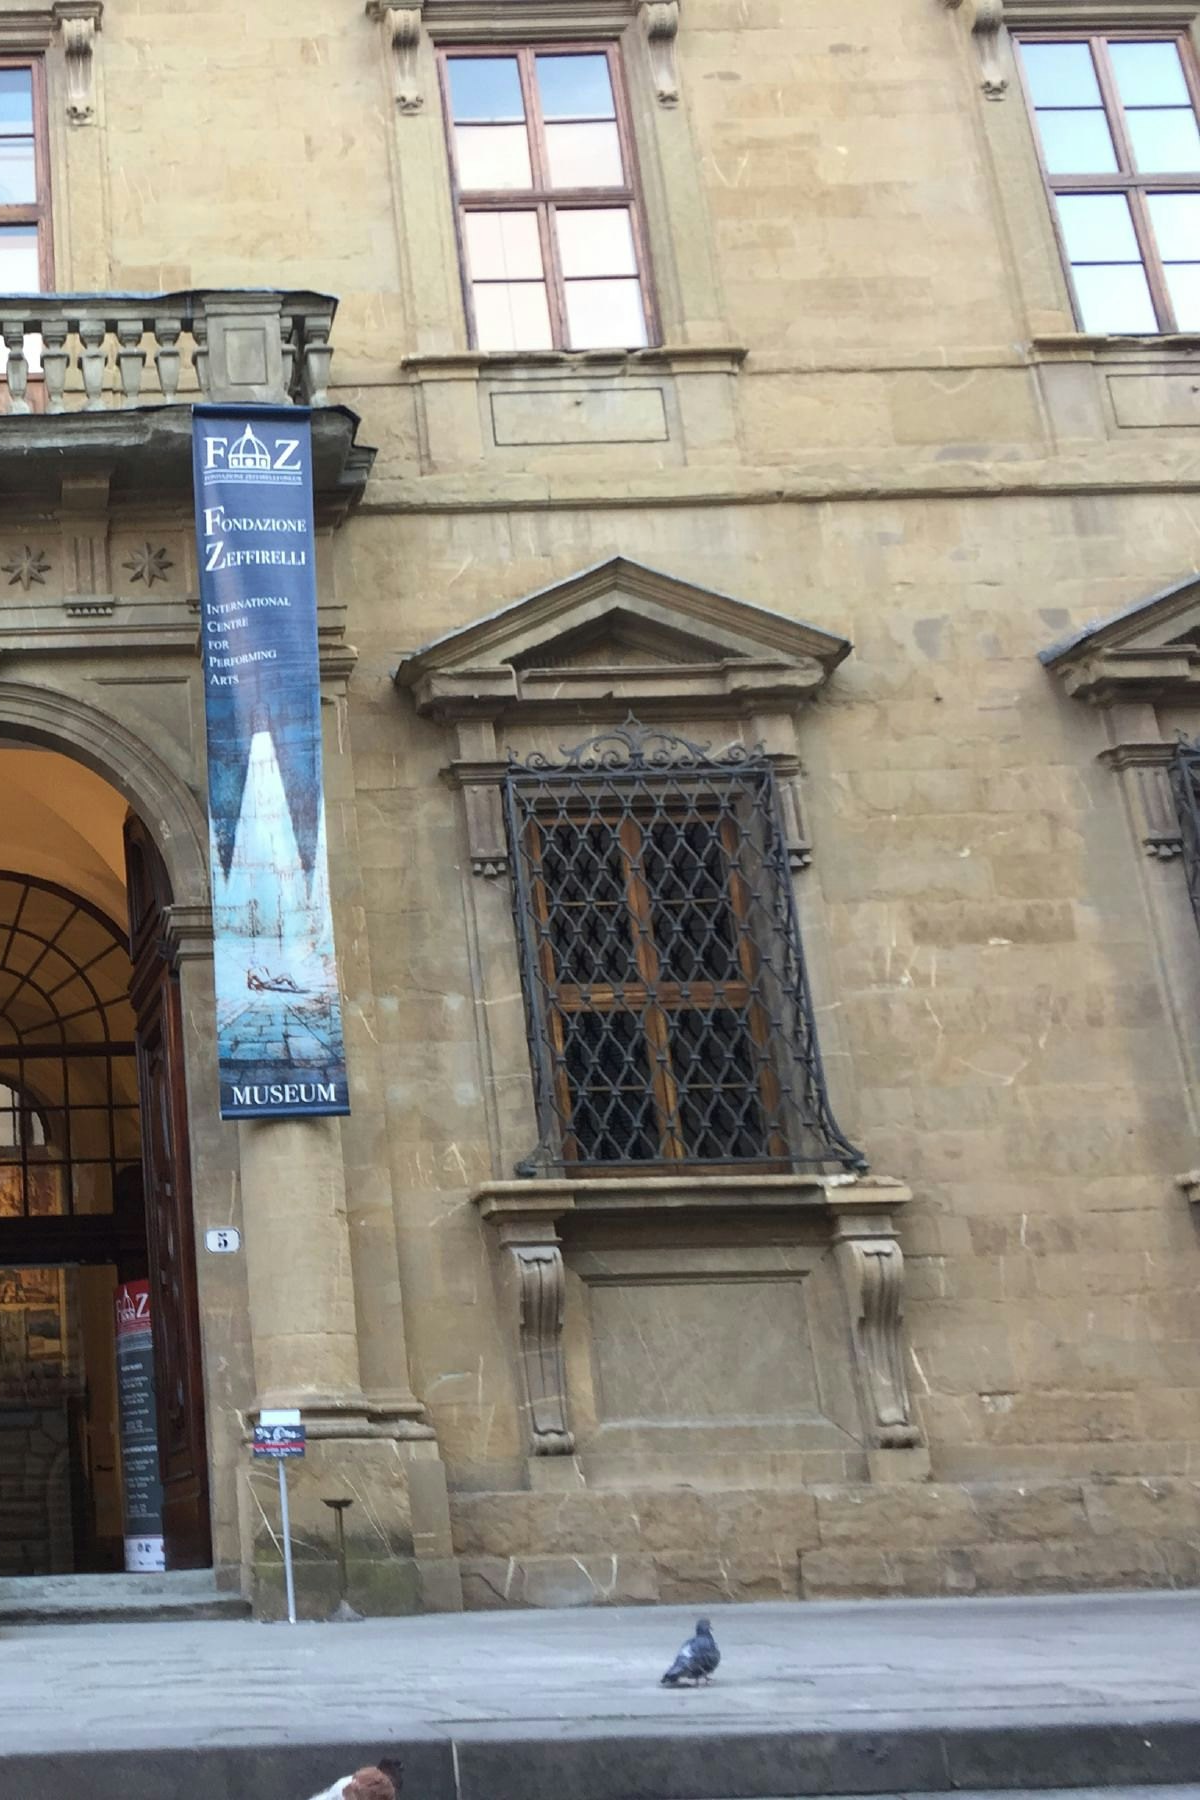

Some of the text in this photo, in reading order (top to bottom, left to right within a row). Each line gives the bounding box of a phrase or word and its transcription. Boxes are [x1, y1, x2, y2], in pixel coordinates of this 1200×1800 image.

[203, 505, 307, 537] FONDAZIONE
[205, 541, 306, 572] ZEFFIRELLI
[206, 596, 291, 616] INTERNATIONAL
[207, 617, 249, 633] CENTRE
[209, 649, 277, 668] PERFORMING
[210, 673, 240, 685] ARTS
[231, 1083, 337, 1105] MUSEUM
[218, 1232, 228, 1249] 5
